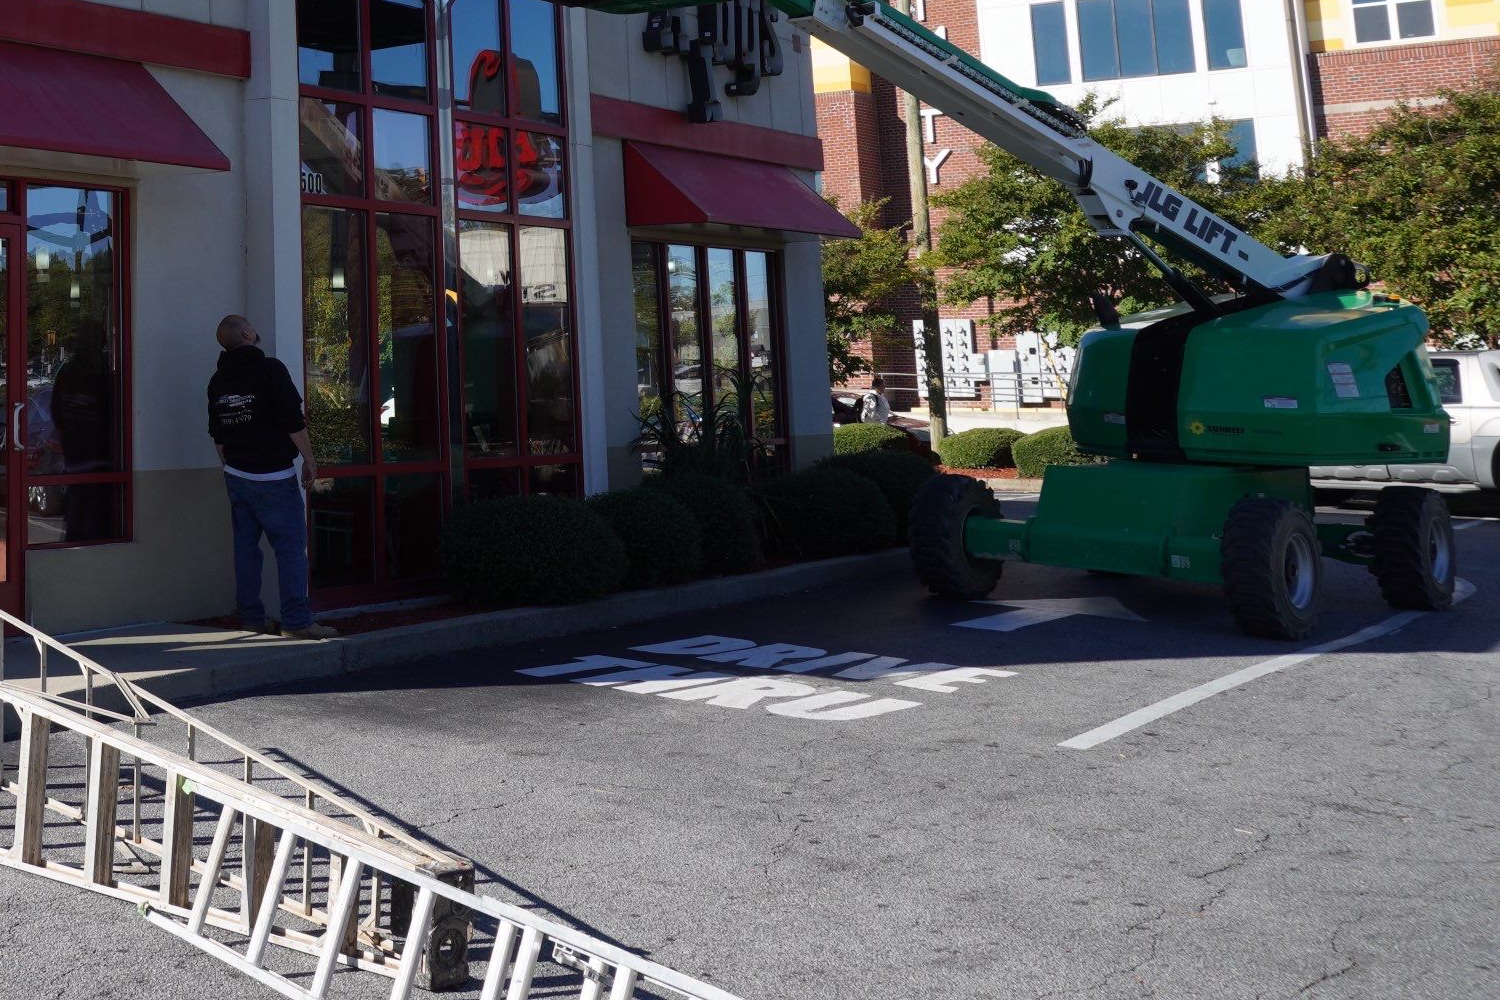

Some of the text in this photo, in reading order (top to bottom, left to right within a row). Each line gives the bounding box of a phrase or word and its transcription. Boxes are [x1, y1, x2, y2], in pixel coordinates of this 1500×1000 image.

[1134, 181, 1239, 254] JLG LIFT
[514, 654, 923, 721] THRU
[627, 634, 1018, 693] DRIVE
